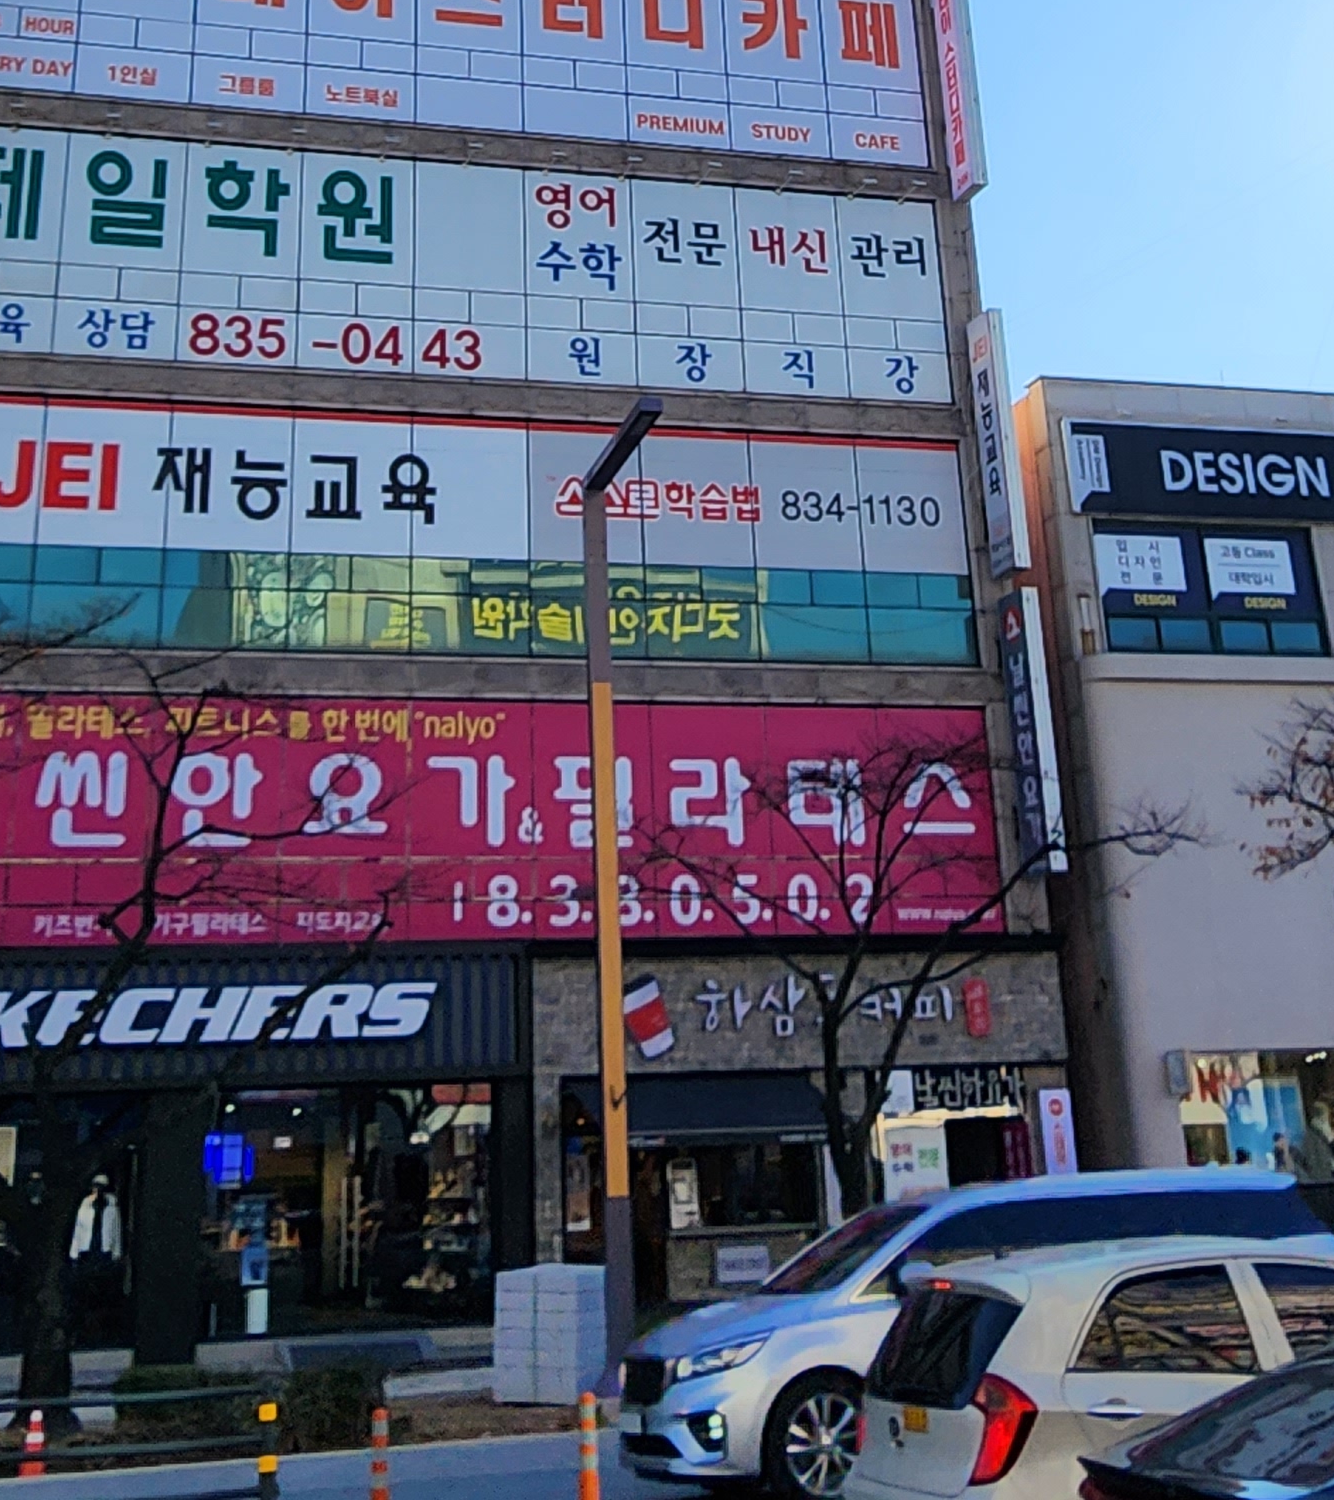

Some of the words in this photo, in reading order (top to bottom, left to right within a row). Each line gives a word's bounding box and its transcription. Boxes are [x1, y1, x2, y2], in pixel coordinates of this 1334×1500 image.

[24, 16, 75, 35] HOUR
[32, 57, 73, 76] DAY
[107, 64, 157, 86] 1인실
[326, 84, 398, 108] 노트북실
[636, 114, 725, 136] PREMIUM
[751, 123, 811, 143] STUDY
[855, 132, 900, 152] CAFE
[535, 183, 617, 229] 영어
[536, 240, 622, 291] 수학
[643, 217, 727, 266] 전문
[750, 226, 830, 275] 내신
[850, 233, 928, 278] 관리
[78, 308, 155, 350] 상담
[152, 447, 437, 524] 재능교육
[1160, 449, 1330, 498] DESIGN
[780, 490, 941, 528] 834-1130
